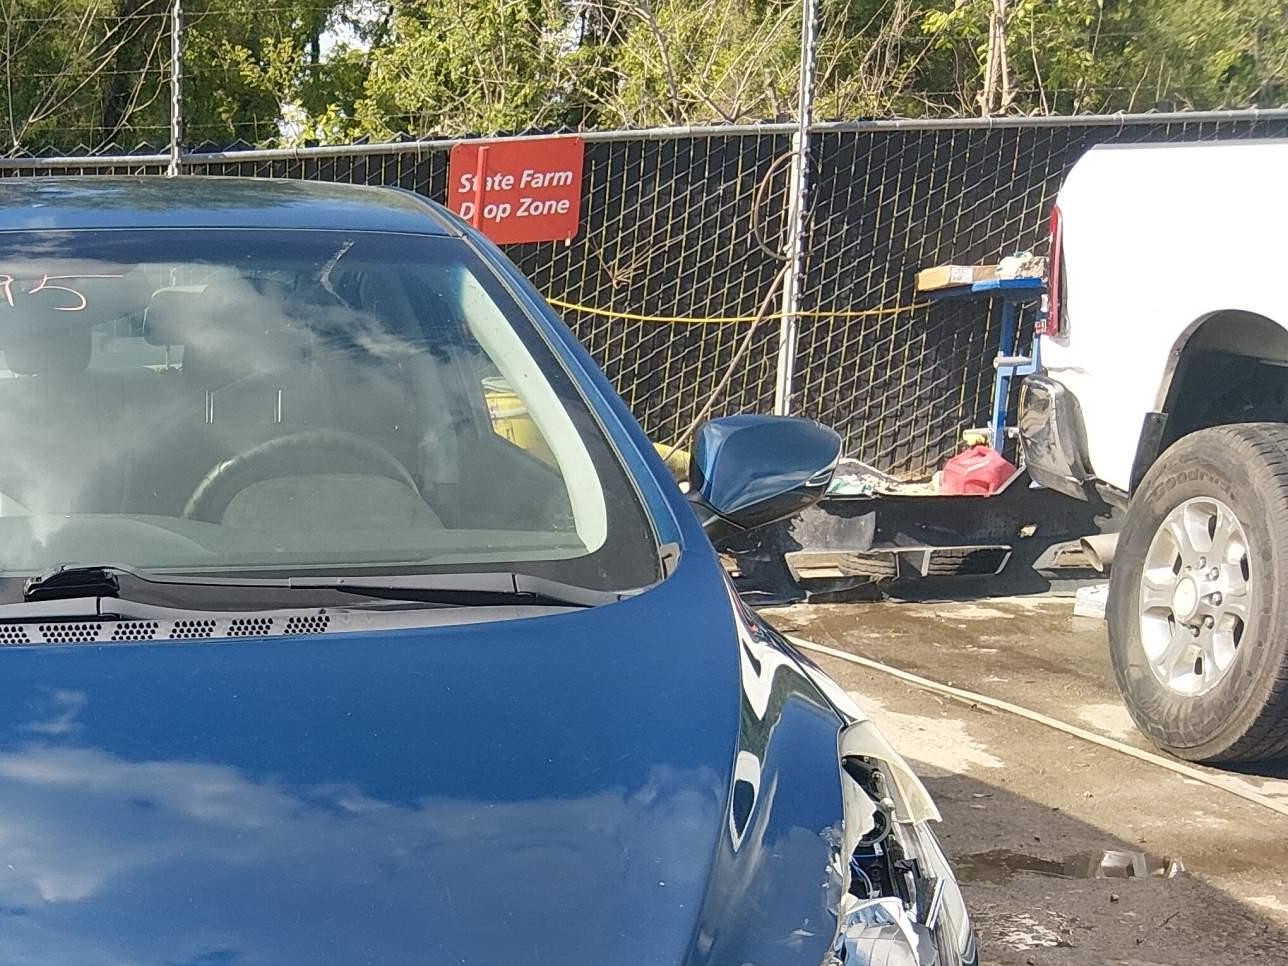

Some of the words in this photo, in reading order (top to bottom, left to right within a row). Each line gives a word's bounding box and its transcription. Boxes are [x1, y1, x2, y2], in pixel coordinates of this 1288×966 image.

[520, 169, 573, 188] Farm
[459, 202, 511, 223] Dop
[516, 197, 570, 217] Zone
